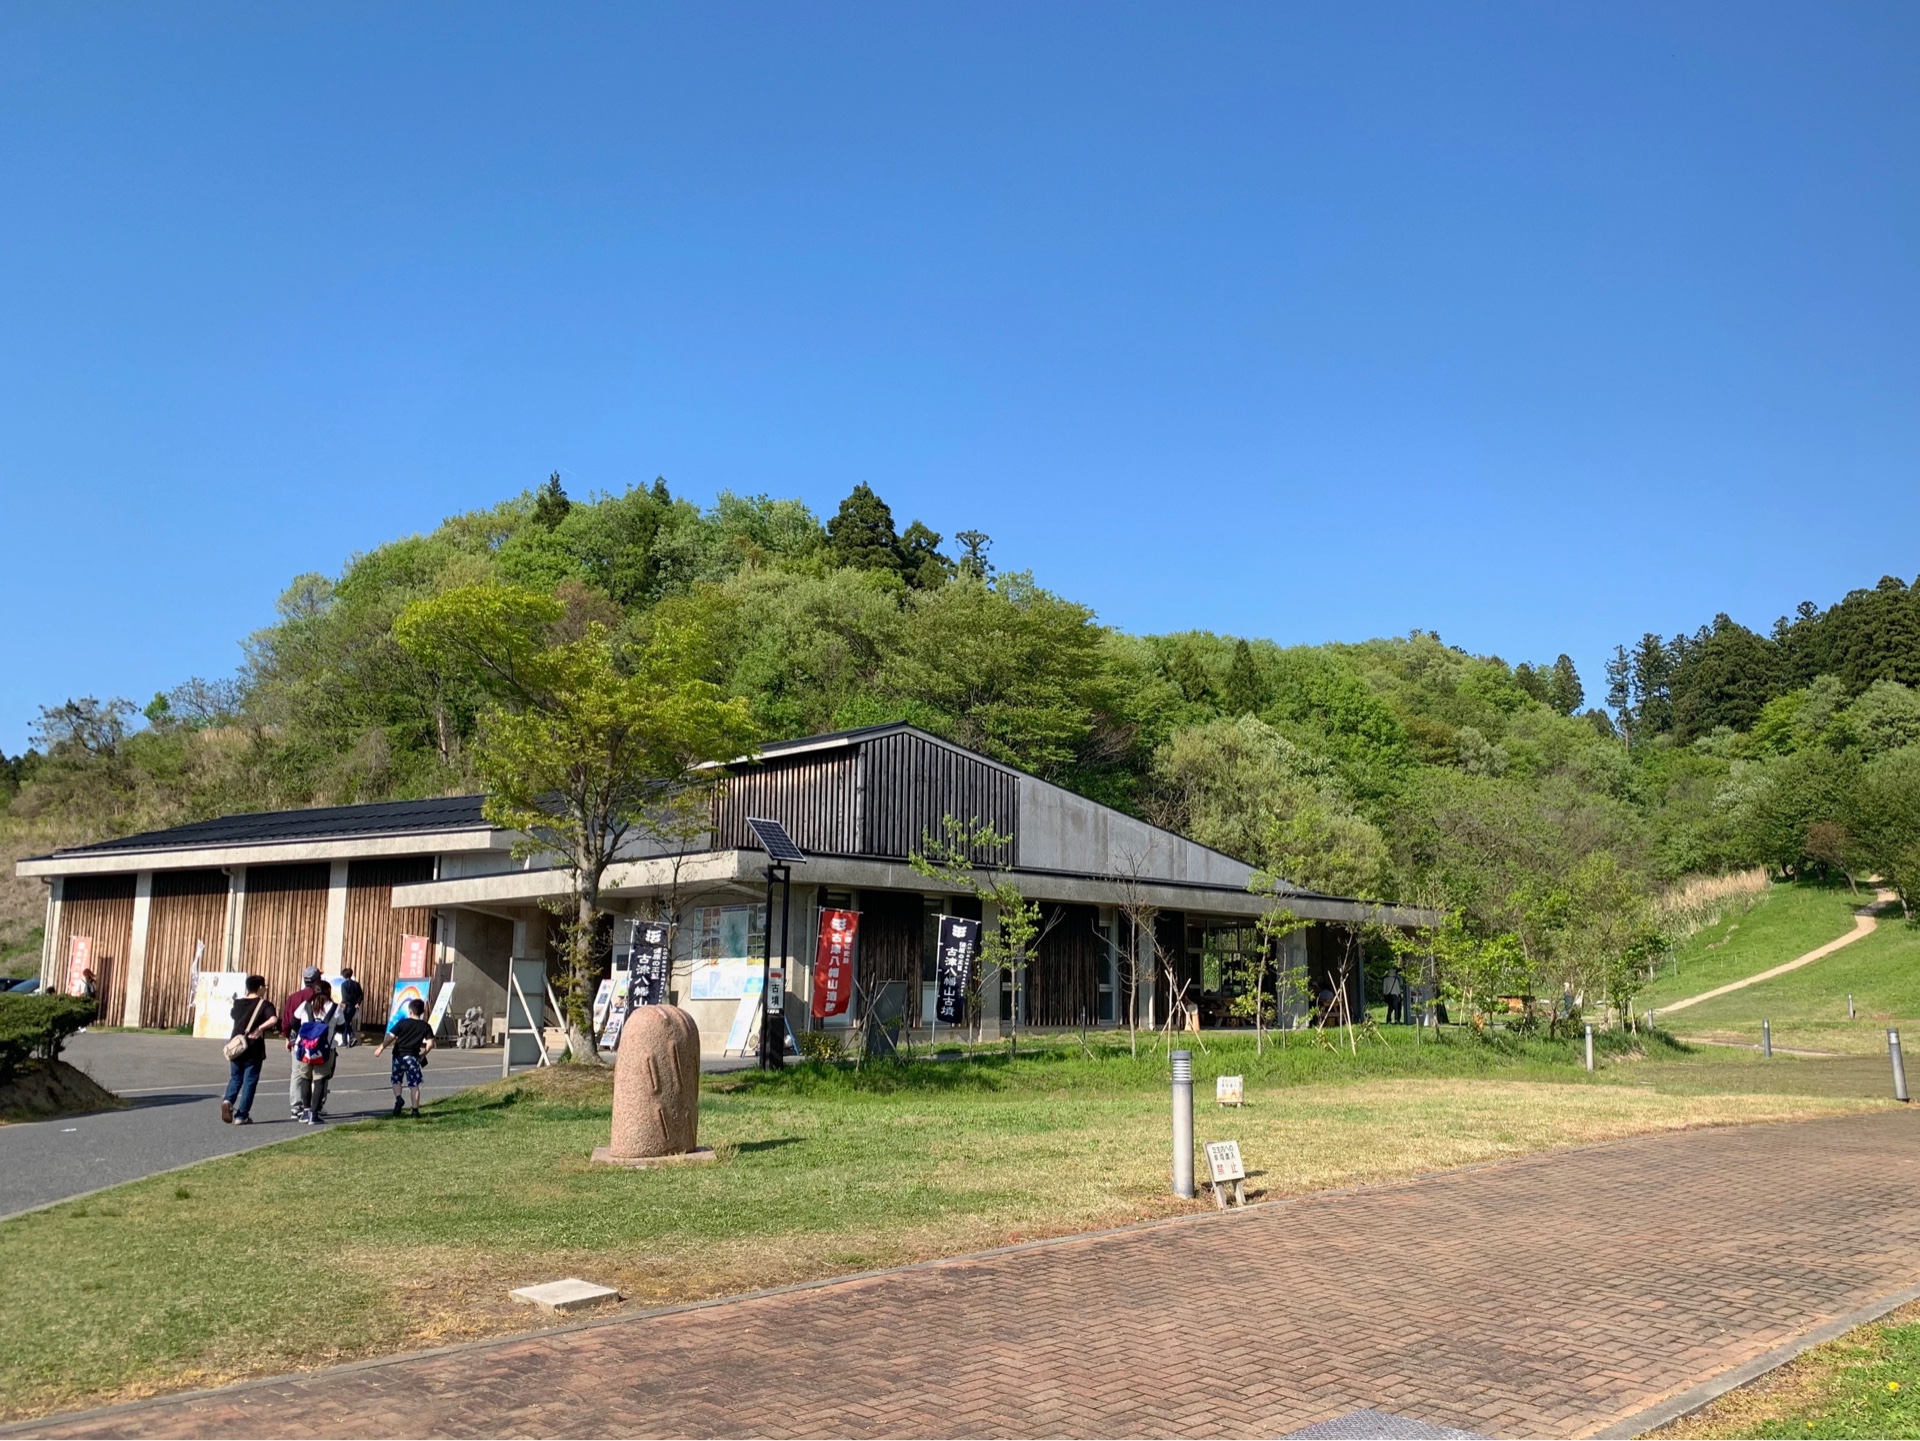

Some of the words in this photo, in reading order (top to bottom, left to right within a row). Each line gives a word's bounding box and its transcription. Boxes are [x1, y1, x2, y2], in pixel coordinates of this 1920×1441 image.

[771, 983, 780, 1006] 古墳
[825, 932, 843, 1012] 古津八幡山遺跡
[941, 946, 957, 1017] 古津八幡山古墳
[1217, 1162, 1238, 1175] 禁止
